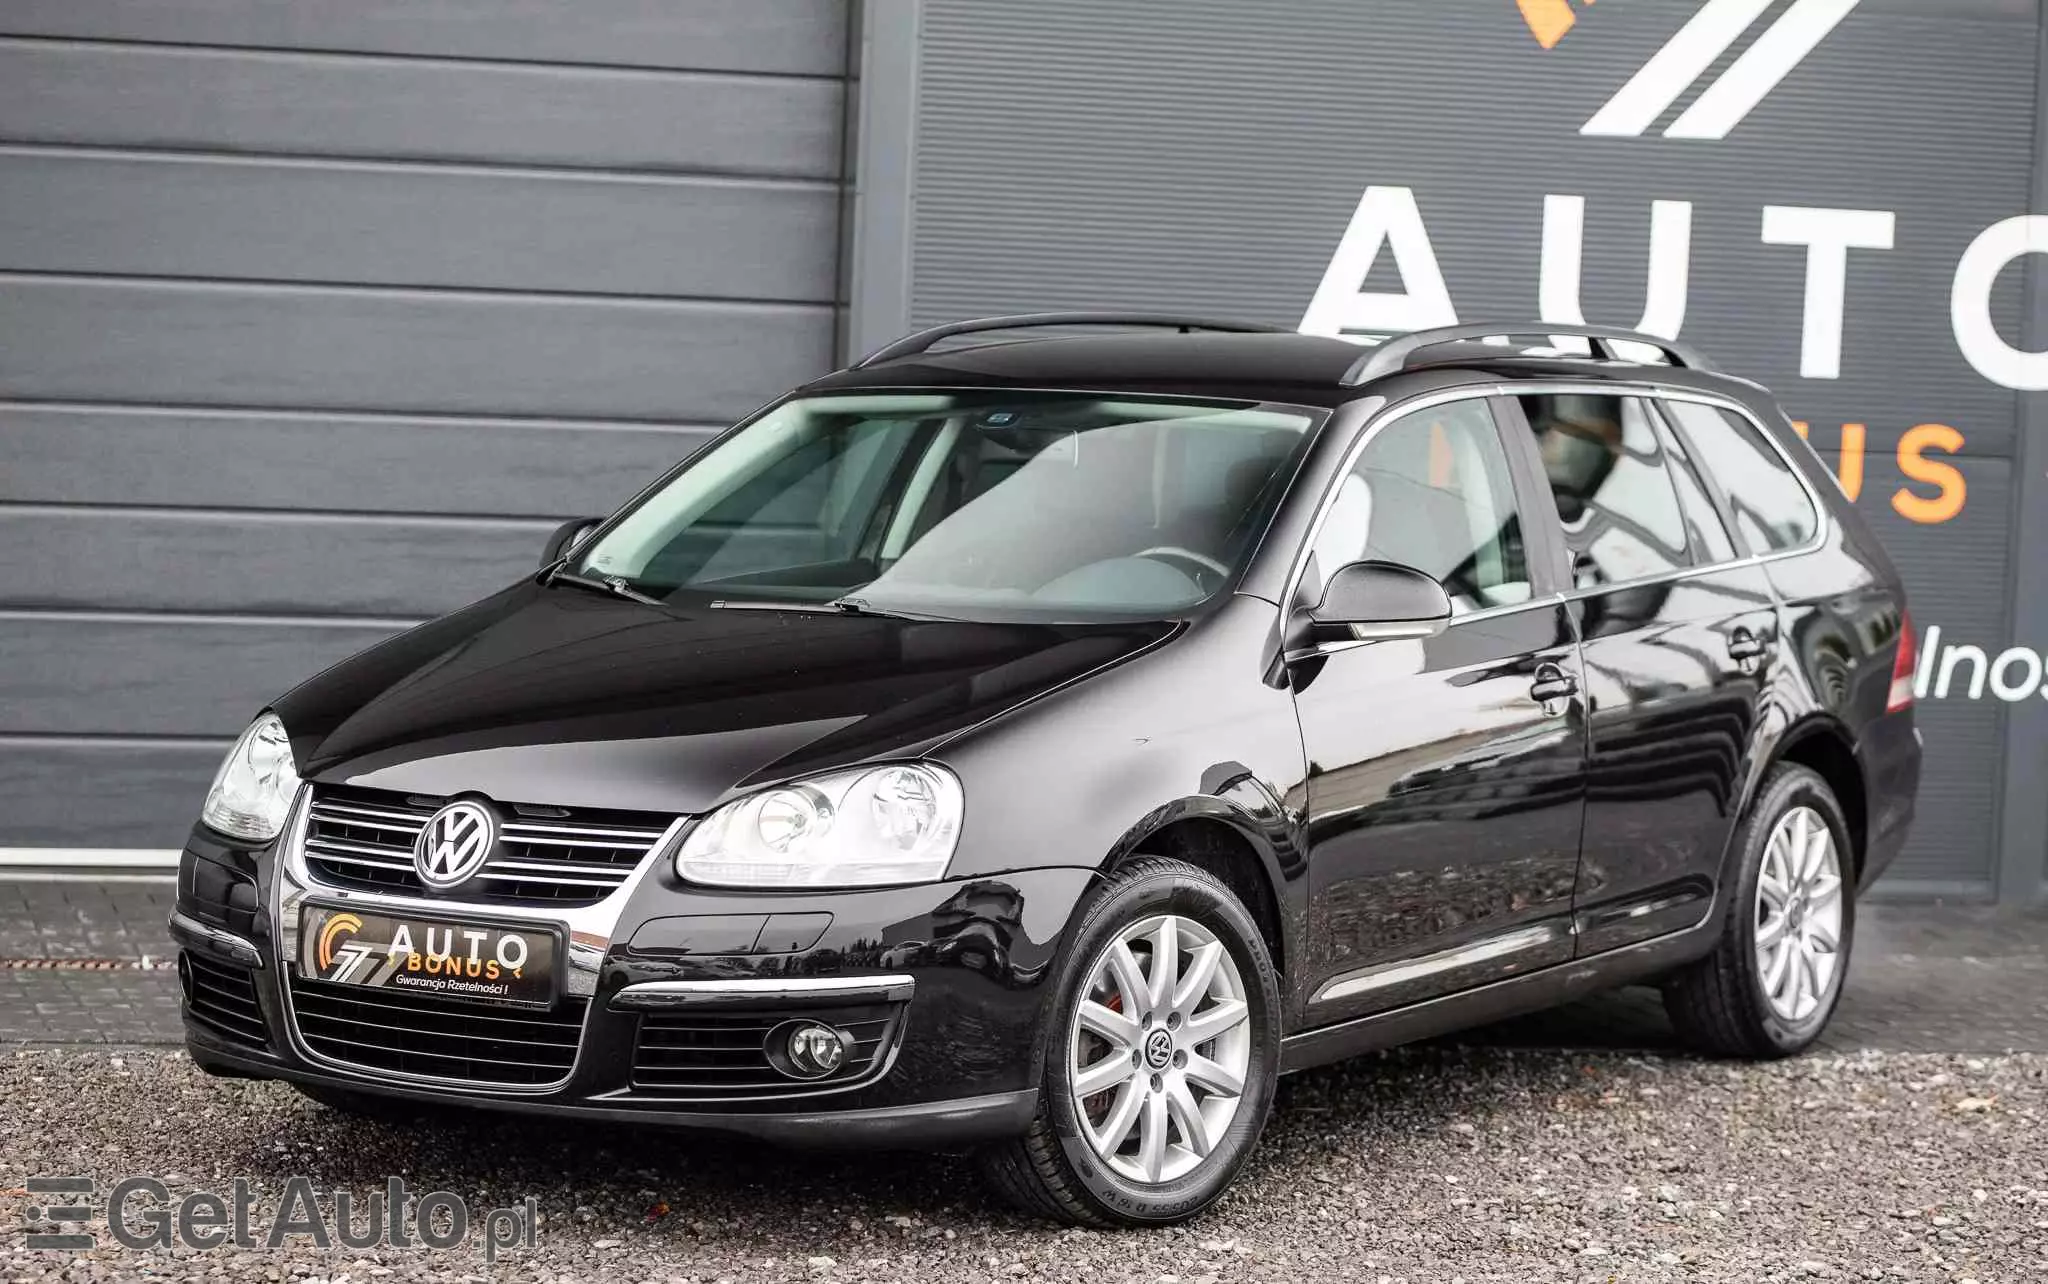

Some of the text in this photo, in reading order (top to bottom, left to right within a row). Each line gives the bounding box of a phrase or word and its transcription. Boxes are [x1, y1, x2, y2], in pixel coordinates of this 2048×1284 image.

[1297, 185, 2048, 392] AUTO
[387, 924, 528, 970] AUTO
[395, 974, 446, 991] Gwarancja
[447, 979, 502, 995] Rzetelności
[407, 952, 500, 980] BONUS
